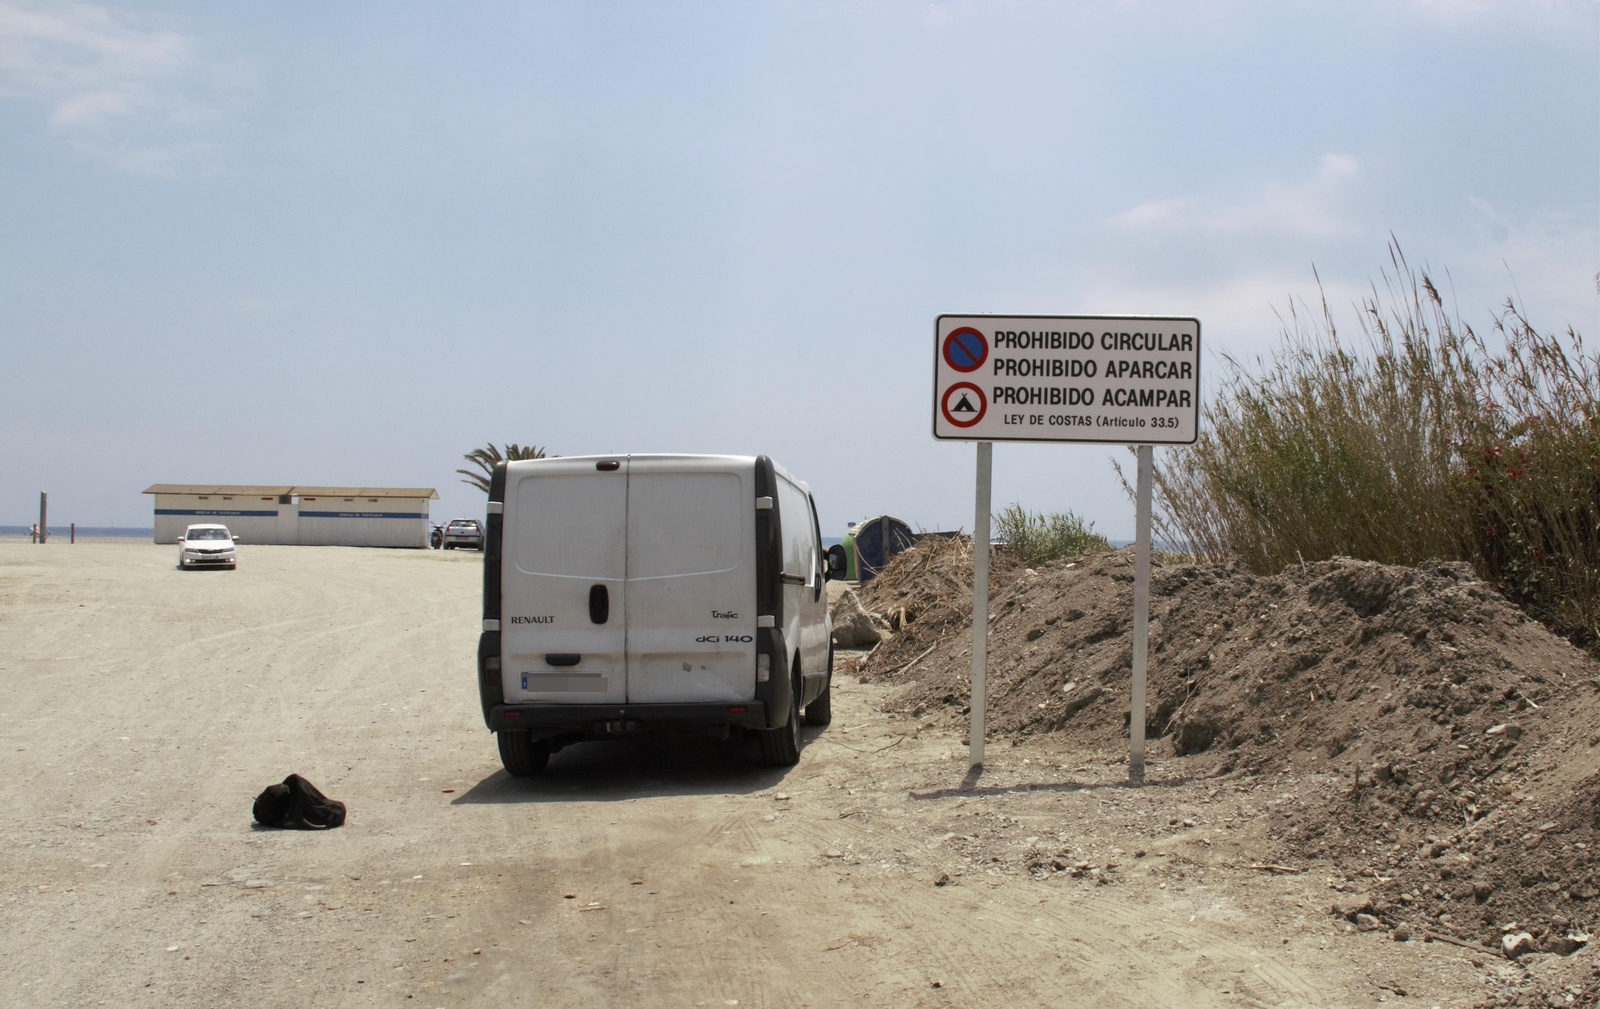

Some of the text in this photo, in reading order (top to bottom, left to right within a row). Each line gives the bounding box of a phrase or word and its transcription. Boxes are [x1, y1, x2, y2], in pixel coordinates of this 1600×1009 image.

[994, 330, 1193, 352] PROHIBIDO CIRCULAR
[993, 358, 1192, 380] PROHIBIDO APARCAR
[992, 386, 1191, 408] PROHIBIDO ACAMPAR
[1004, 414, 1180, 429] LEY DE COSTAS (Artículo 33.5)
[511, 615, 555, 625] RENAULT
[711, 610, 739, 620] Trafic
[695, 635, 754, 643] dCi 140
